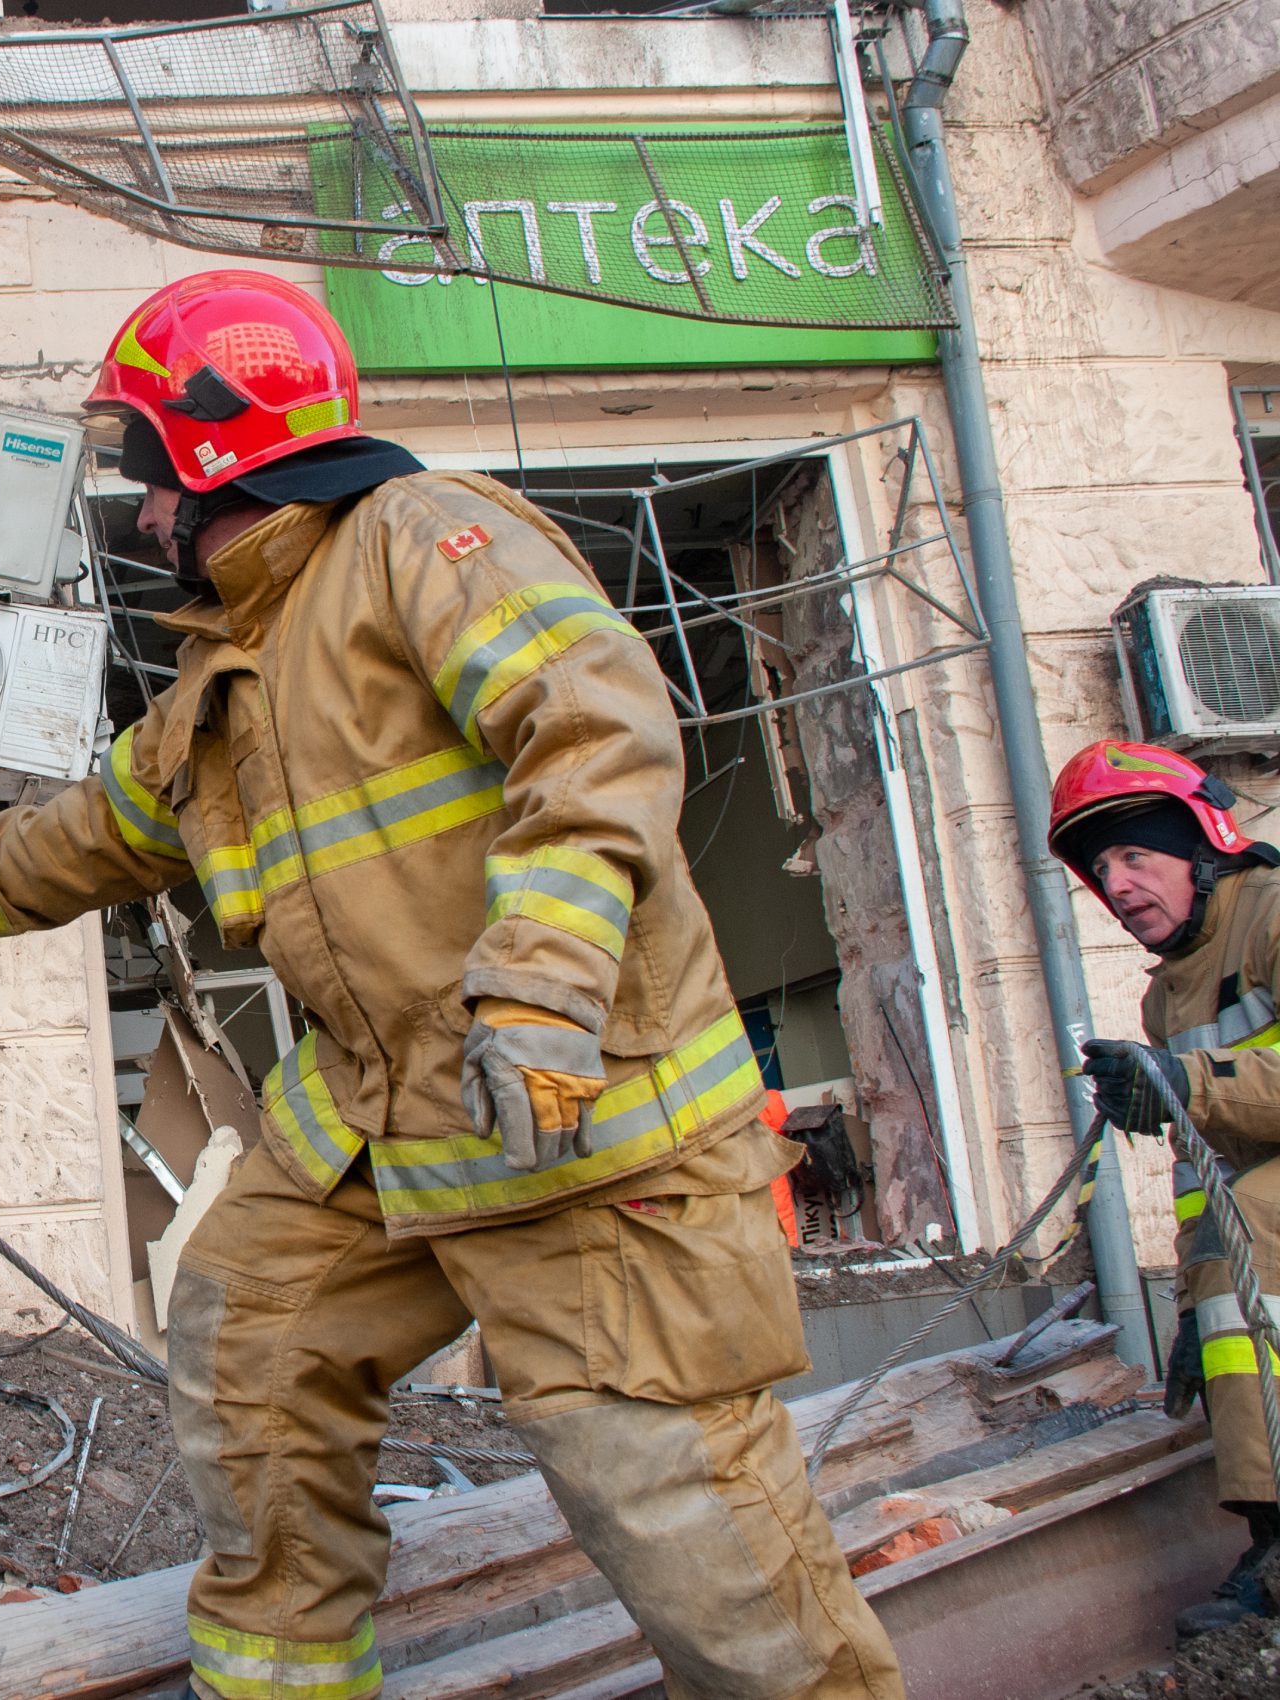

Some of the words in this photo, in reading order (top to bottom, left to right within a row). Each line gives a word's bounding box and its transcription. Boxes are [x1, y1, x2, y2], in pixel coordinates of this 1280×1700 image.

[378, 195, 878, 286] аптека
[6, 437, 61, 458] Hisense
[34, 624, 86, 648] HPC
